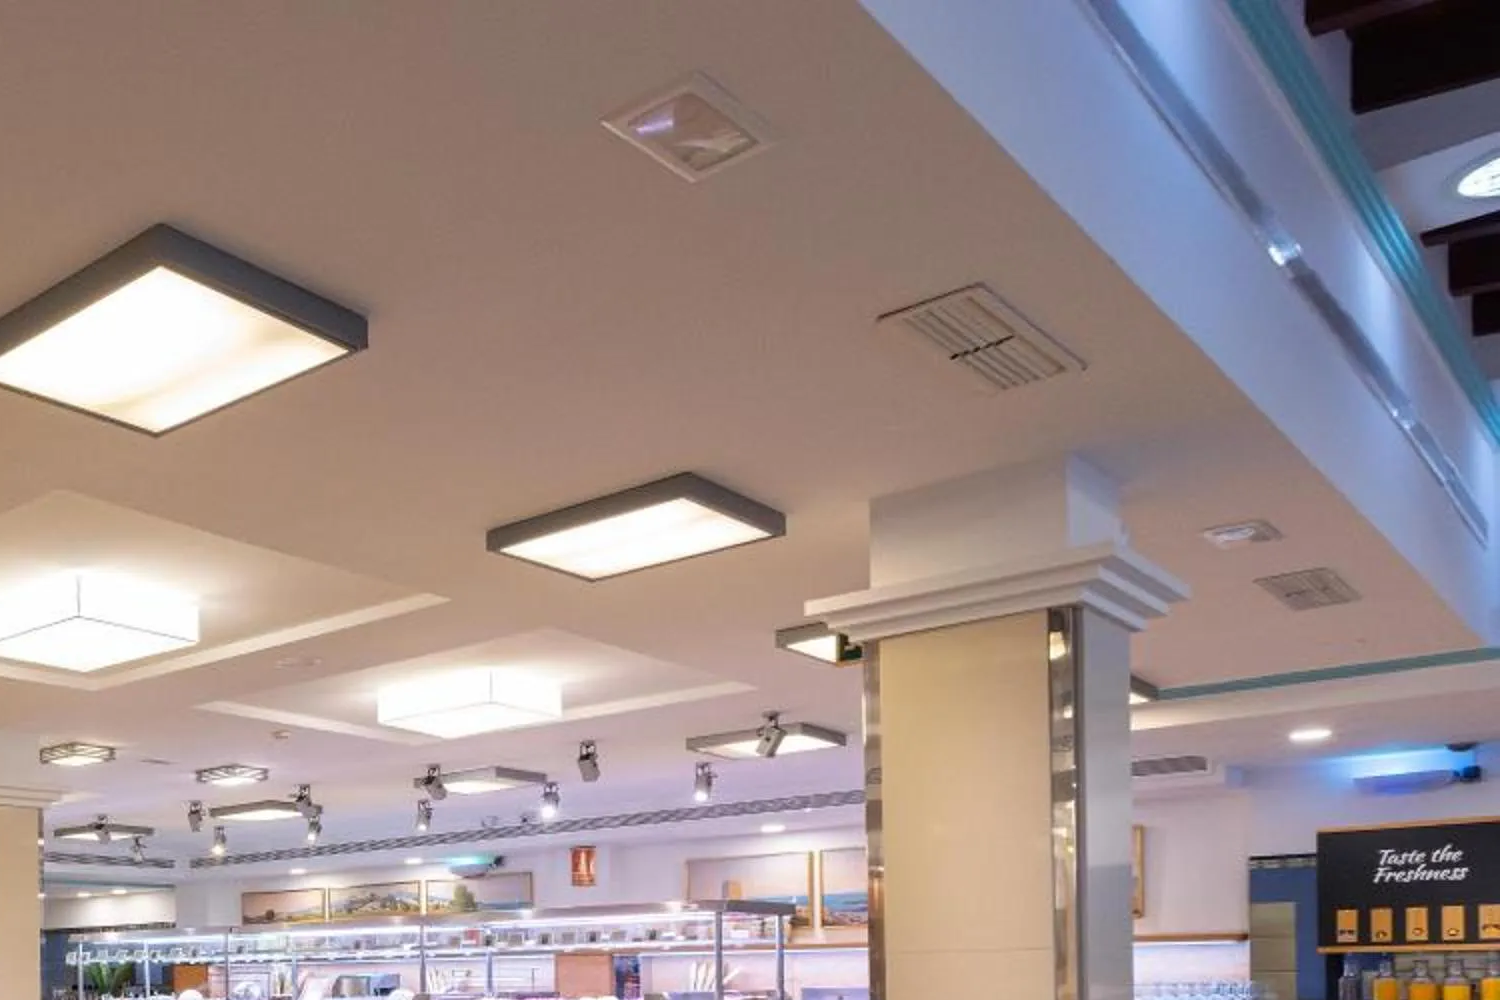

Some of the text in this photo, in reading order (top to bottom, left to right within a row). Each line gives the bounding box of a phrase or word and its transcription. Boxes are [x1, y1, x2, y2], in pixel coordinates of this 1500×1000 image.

[1379, 843, 1463, 866] Taste the
[1373, 863, 1468, 884] Freshness
